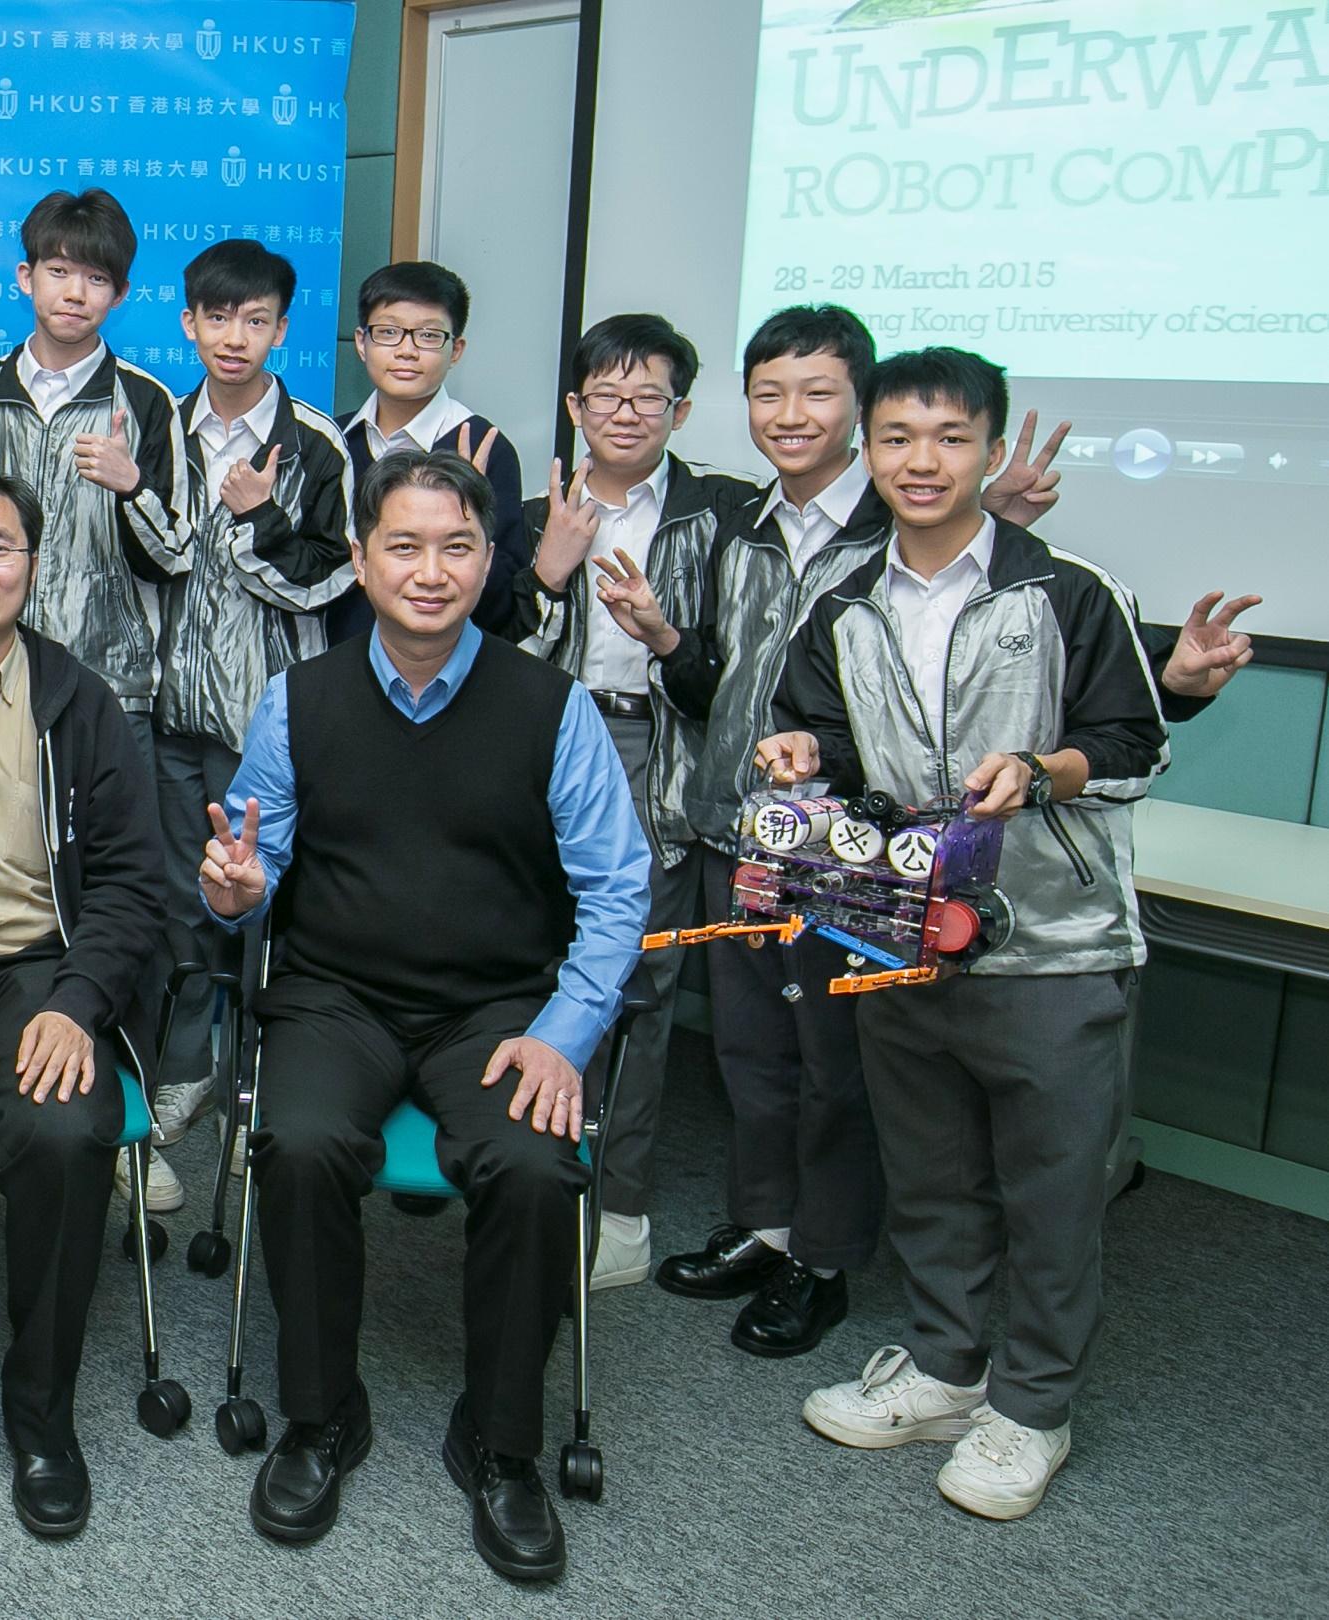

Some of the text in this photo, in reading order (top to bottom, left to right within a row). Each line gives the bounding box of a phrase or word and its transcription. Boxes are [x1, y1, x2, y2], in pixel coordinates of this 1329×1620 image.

[51, 31, 183, 50] 香港科技大學
[233, 36, 321, 54] HKUST
[788, 3, 1329, 132] UNDERWA
[30, 95, 119, 113] HKUST
[128, 96, 260, 116] 香港科技大學
[309, 101, 340, 119] HK
[77, 158, 208, 178] 香港科技大學
[258, 163, 341, 182] HKUST
[780, 152, 1035, 219] ROBOT
[144, 224, 232, 240] HKUST
[773, 266, 807, 291] 28
[830, 265, 864, 290] 29
[871, 263, 970, 290] March
[977, 261, 1055, 289] 2015
[910, 307, 989, 339] Kong
[996, 306, 1158, 341] University
[1165, 305, 1201, 333] of
[1203, 305, 1329, 335] Scienc
[299, 351, 329, 368] HK
